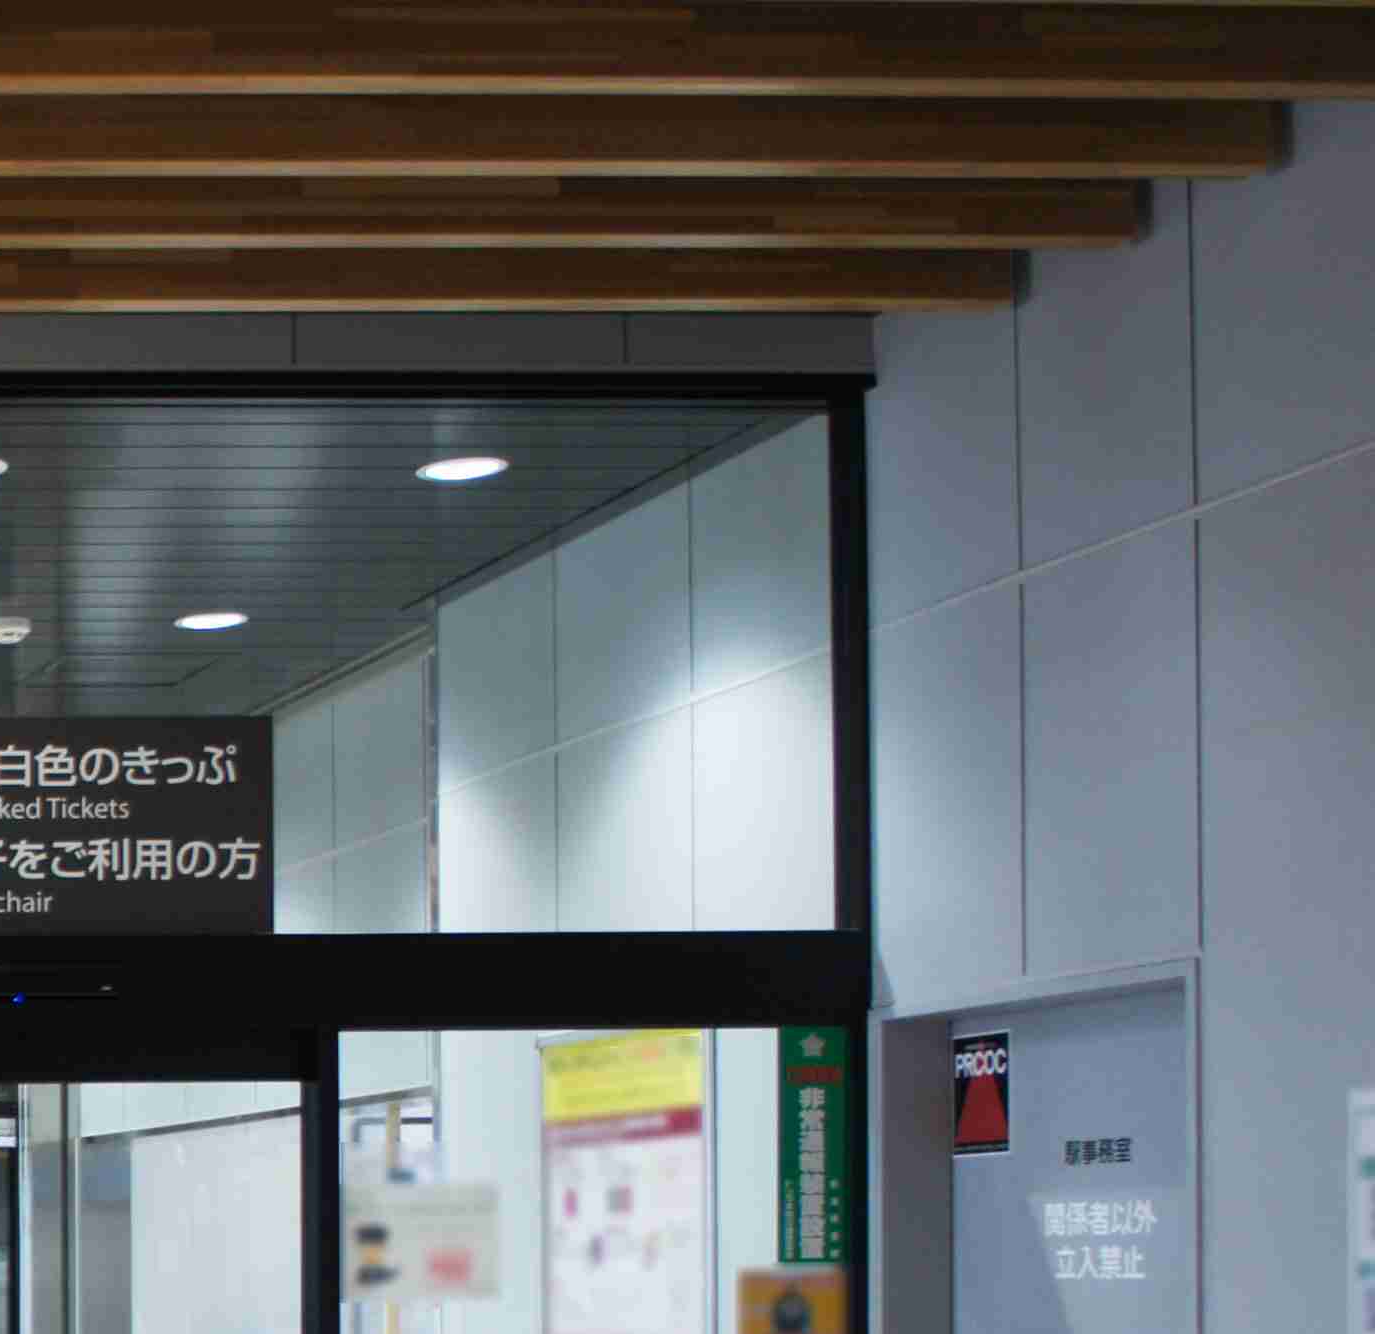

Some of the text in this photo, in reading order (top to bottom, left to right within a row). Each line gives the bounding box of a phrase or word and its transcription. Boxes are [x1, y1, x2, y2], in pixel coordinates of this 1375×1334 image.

[48, 797, 131, 821] Tickets
[1043, 1199, 1158, 1237] 関係者以外
[1054, 1244, 1146, 1279] 立入禁止
